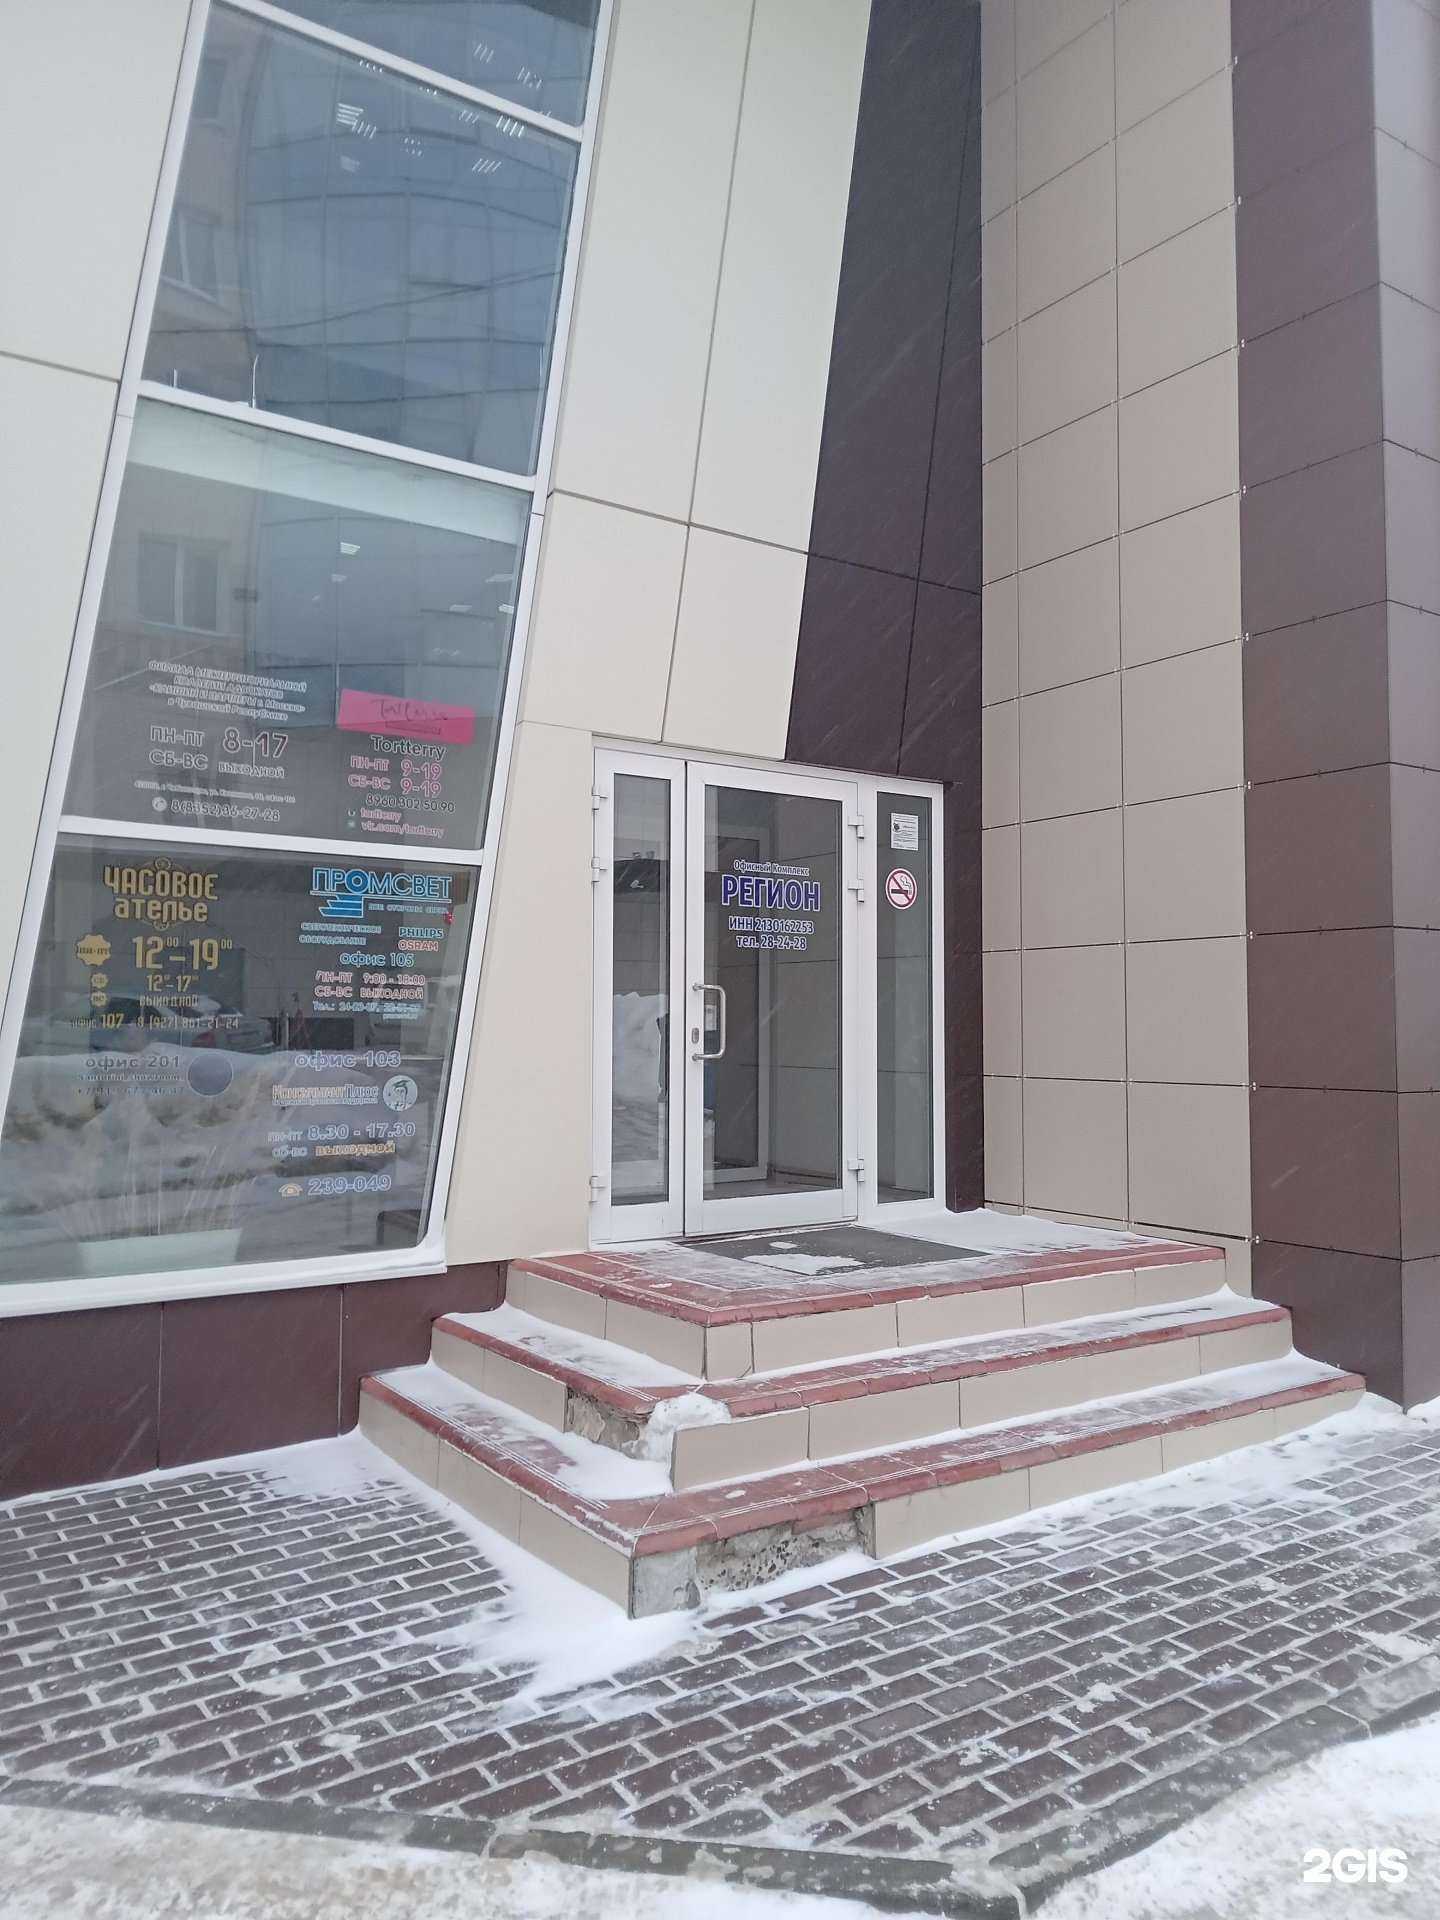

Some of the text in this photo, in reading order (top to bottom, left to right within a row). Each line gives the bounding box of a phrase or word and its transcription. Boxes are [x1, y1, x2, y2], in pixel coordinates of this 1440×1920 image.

[150, 725, 289, 759] ПН-ПТ 8-17
[370, 734, 447, 762] Tortterry
[149, 749, 209, 771] СБ-ВС
[400, 759, 442, 781] 9-19
[400, 777, 442, 798] 9-19
[733, 859, 810, 877] Офисный Комплекс
[104, 864, 219, 901] ЧАСОВОЕ
[312, 866, 453, 899] ПРОМСВЕТ
[721, 874, 821, 912] РЕГИОН
[114, 897, 209, 923] ателье
[398, 926, 445, 940] PHILIPS
[728, 916, 815, 935] ИНН 2130162253
[397, 939, 439, 952] OSRAM
[736, 934, 807, 951] тел. 28-24-28
[339, 950, 415, 968] офис 105
[101, 1012, 125, 1029] 107
[294, 1050, 402, 1072] офис 103
[307, 1174, 392, 1196] 239-049
